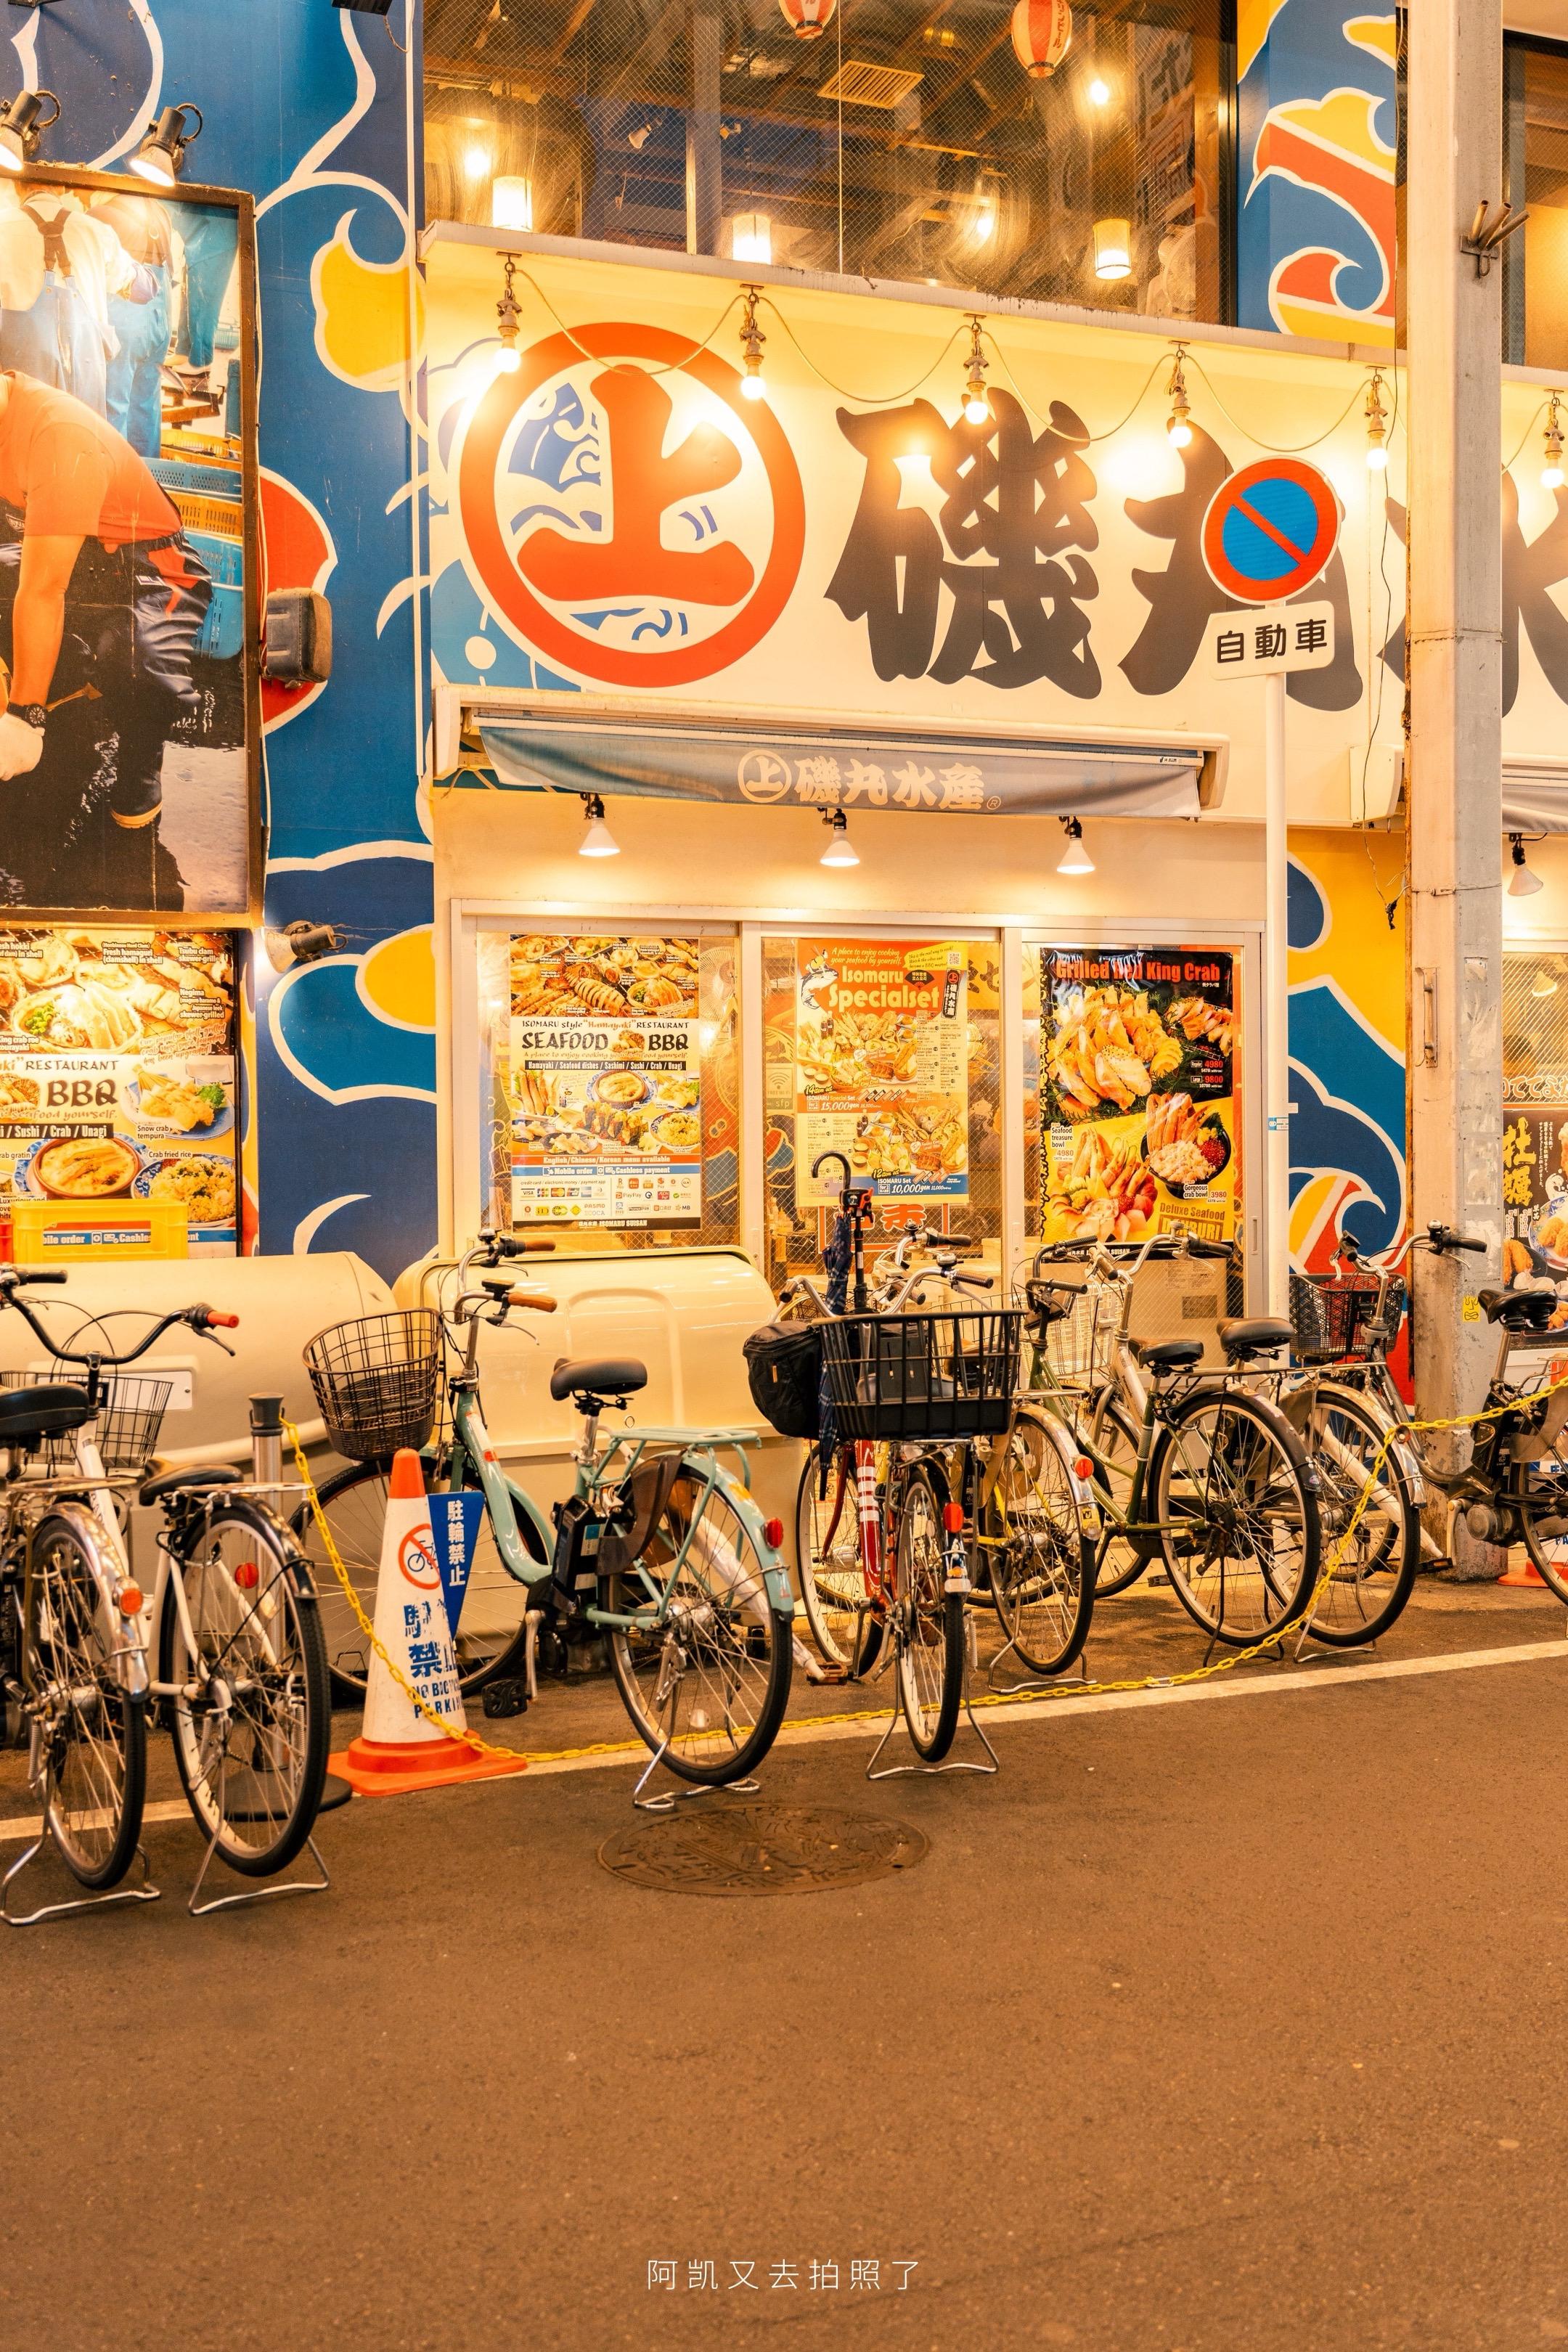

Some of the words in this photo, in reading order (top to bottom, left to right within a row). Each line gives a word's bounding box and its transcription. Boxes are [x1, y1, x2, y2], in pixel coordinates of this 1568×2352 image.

[517, 364, 755, 607] 上
[1215, 619, 1328, 665] 自動車
[794, 756, 985, 810] 磯丸水産
[26, 950, 43, 958] shell
[121, 948, 153, 957] hamaguri
[179, 947, 197, 955] Tsubu
[838, 947, 854, 956] place
[862, 948, 877, 957] enjoy
[878, 947, 899, 957] cooking
[842, 965, 904, 984] Isomaru
[1056, 960, 1109, 979] Grilled
[1114, 961, 1143, 980] Red
[1146, 962, 1180, 982] King
[1184, 963, 1220, 981] Crab
[179, 989, 204, 997] Negima
[829, 984, 940, 1013] Specialset
[179, 1010, 225, 1020] skewer-grilled
[562, 1020, 583, 1029] style
[522, 1032, 608, 1050] SEAFOOD
[648, 1033, 689, 1051] BBQ
[25, 1061, 118, 1071] RESTAURANT
[528, 1061, 554, 1071] Hamayaki
[560, 1061, 581, 1070] Seafood
[582, 1061, 599, 1070] dishes
[605, 1061, 625, 1070] Sashimi
[631, 1061, 645, 1070] Sushi
[650, 1061, 662, 1070] Crab
[668, 1061, 682, 1071] Unagi
[46, 1079, 118, 1108] BBQ
[776, 1099, 790, 1108] sfp
[63, 1109, 118, 1121] yourself.
[15, 1126, 40, 1138] Sushi
[50, 1126, 72, 1138] Crab
[81, 1126, 107, 1139] Unagi
[644, 1167, 670, 1175] payment
[1160, 1203, 1189, 1216] Deluxe
[1191, 1206, 1225, 1220] Seafood
[61, 1235, 85, 1244] order
[446, 1499, 466, 1587] 駐輪禁止
